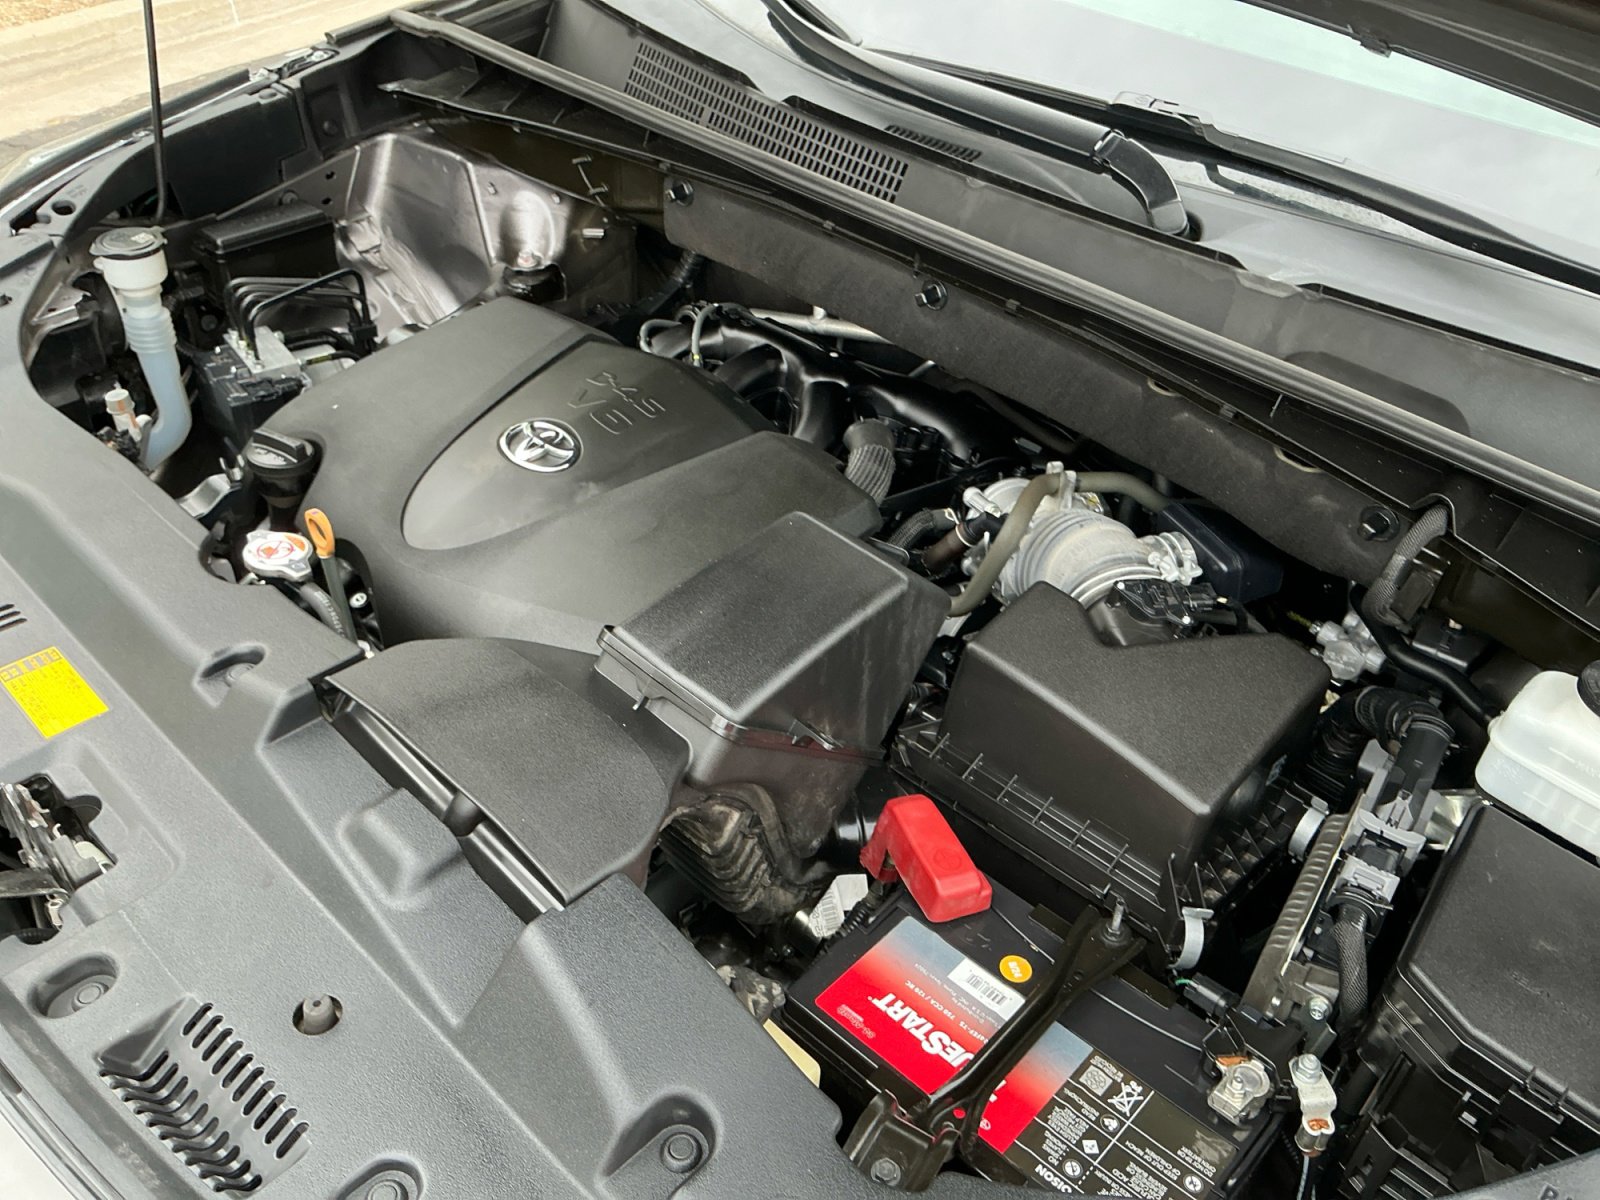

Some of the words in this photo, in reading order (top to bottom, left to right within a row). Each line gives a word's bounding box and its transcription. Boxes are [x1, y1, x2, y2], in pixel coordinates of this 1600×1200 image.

[567, 389, 633, 434] V6
[904, 979, 915, 989] RC
[928, 998, 944, 1011] CCA
[1080, 1107, 1096, 1121] READ
[1124, 1139, 1144, 1156] REACH
[1046, 1154, 1059, 1166] NO
[1142, 1153, 1152, 1162] OF
[1125, 1165, 1136, 1175] OR
[1151, 1159, 1164, 1170] OUT
[1171, 1166, 1181, 1176] OF
[1200, 1159, 1217, 1173] OPEN
[1033, 1163, 1073, 1196] OISON
[1110, 1167, 1129, 1183] ACID
[1163, 1167, 1177, 1180] KEEP
[1126, 1179, 1155, 1200] ULFURIC
[1129, 1175, 1149, 1191] CAUSE
[1147, 1188, 1162, 1200] CAN
